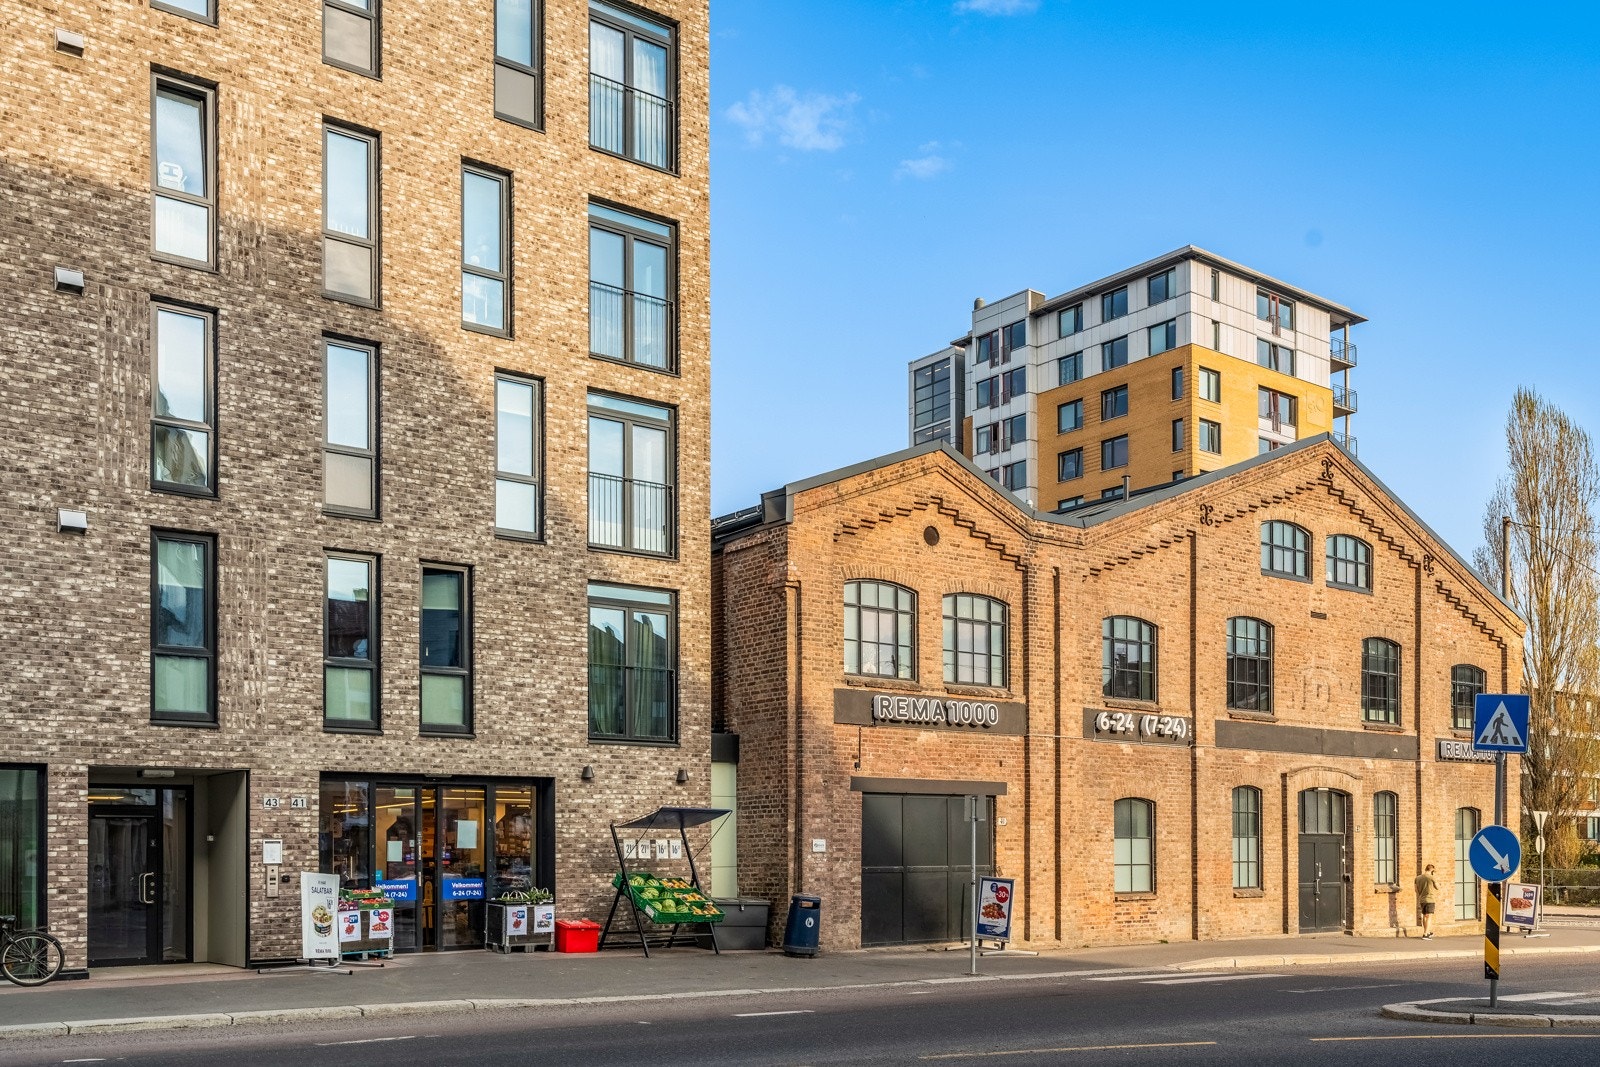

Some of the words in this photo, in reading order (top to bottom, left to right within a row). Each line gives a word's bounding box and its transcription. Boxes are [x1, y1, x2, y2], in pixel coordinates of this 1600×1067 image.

[876, 695, 946, 722] REMA
[949, 700, 999, 726] 1000
[1098, 711, 1135, 732] 6-24
[1144, 714, 1187, 739] (7-24)
[265, 798, 278, 807] 43
[292, 799, 304, 808] 41
[311, 886, 332, 894] SALATBAR
